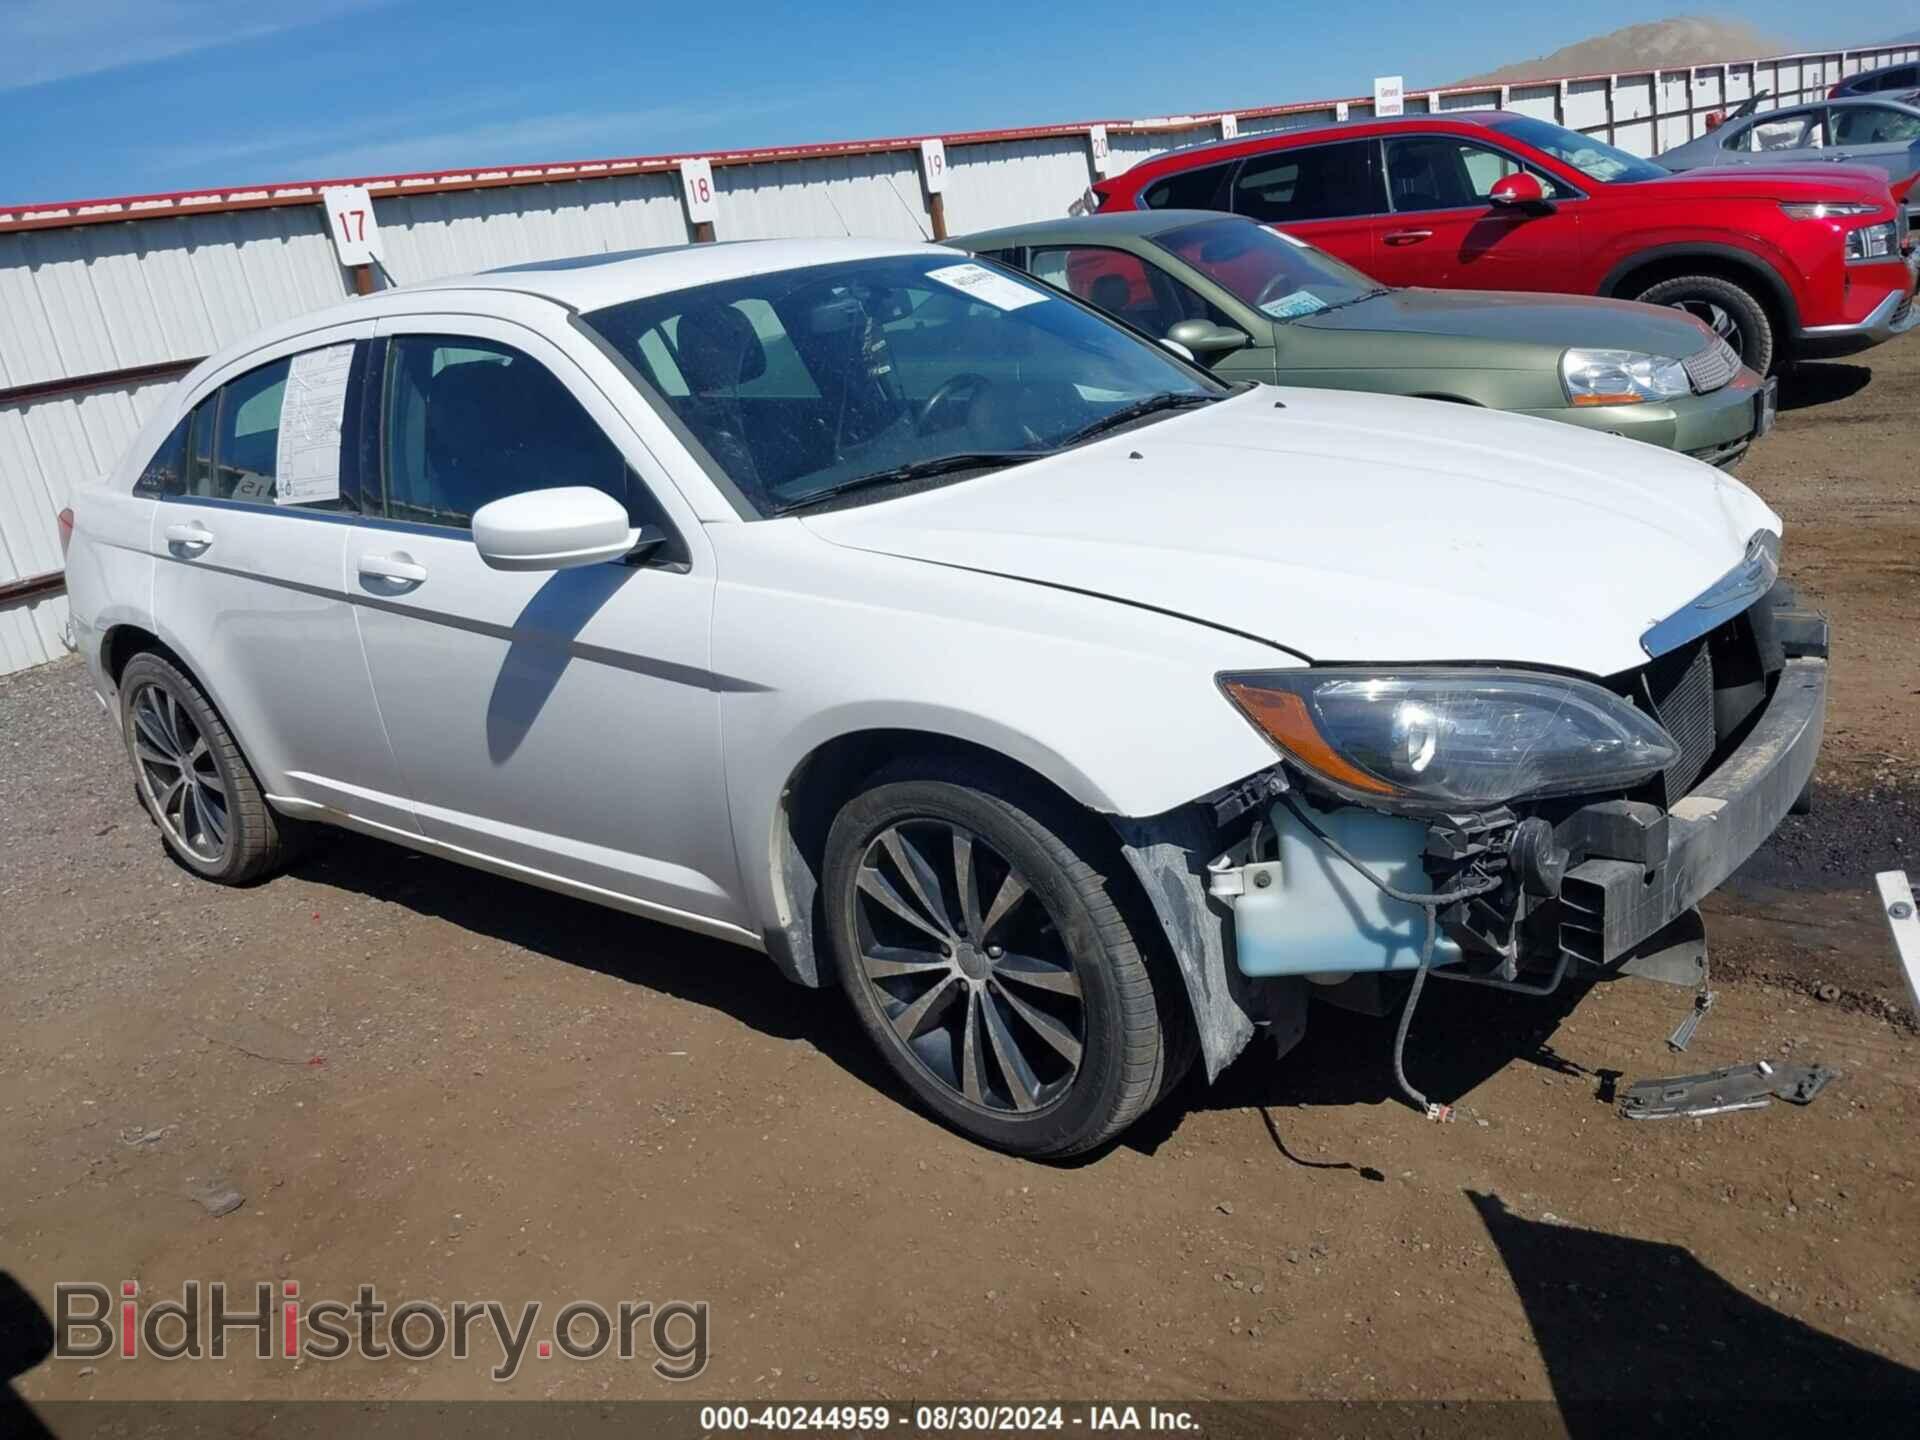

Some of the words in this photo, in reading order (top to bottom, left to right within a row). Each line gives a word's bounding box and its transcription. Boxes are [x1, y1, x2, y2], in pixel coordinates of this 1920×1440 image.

[1094, 138, 1107, 159] 20
[928, 154, 942, 177] 19
[690, 177, 710, 204] 18
[339, 210, 364, 242] 17
